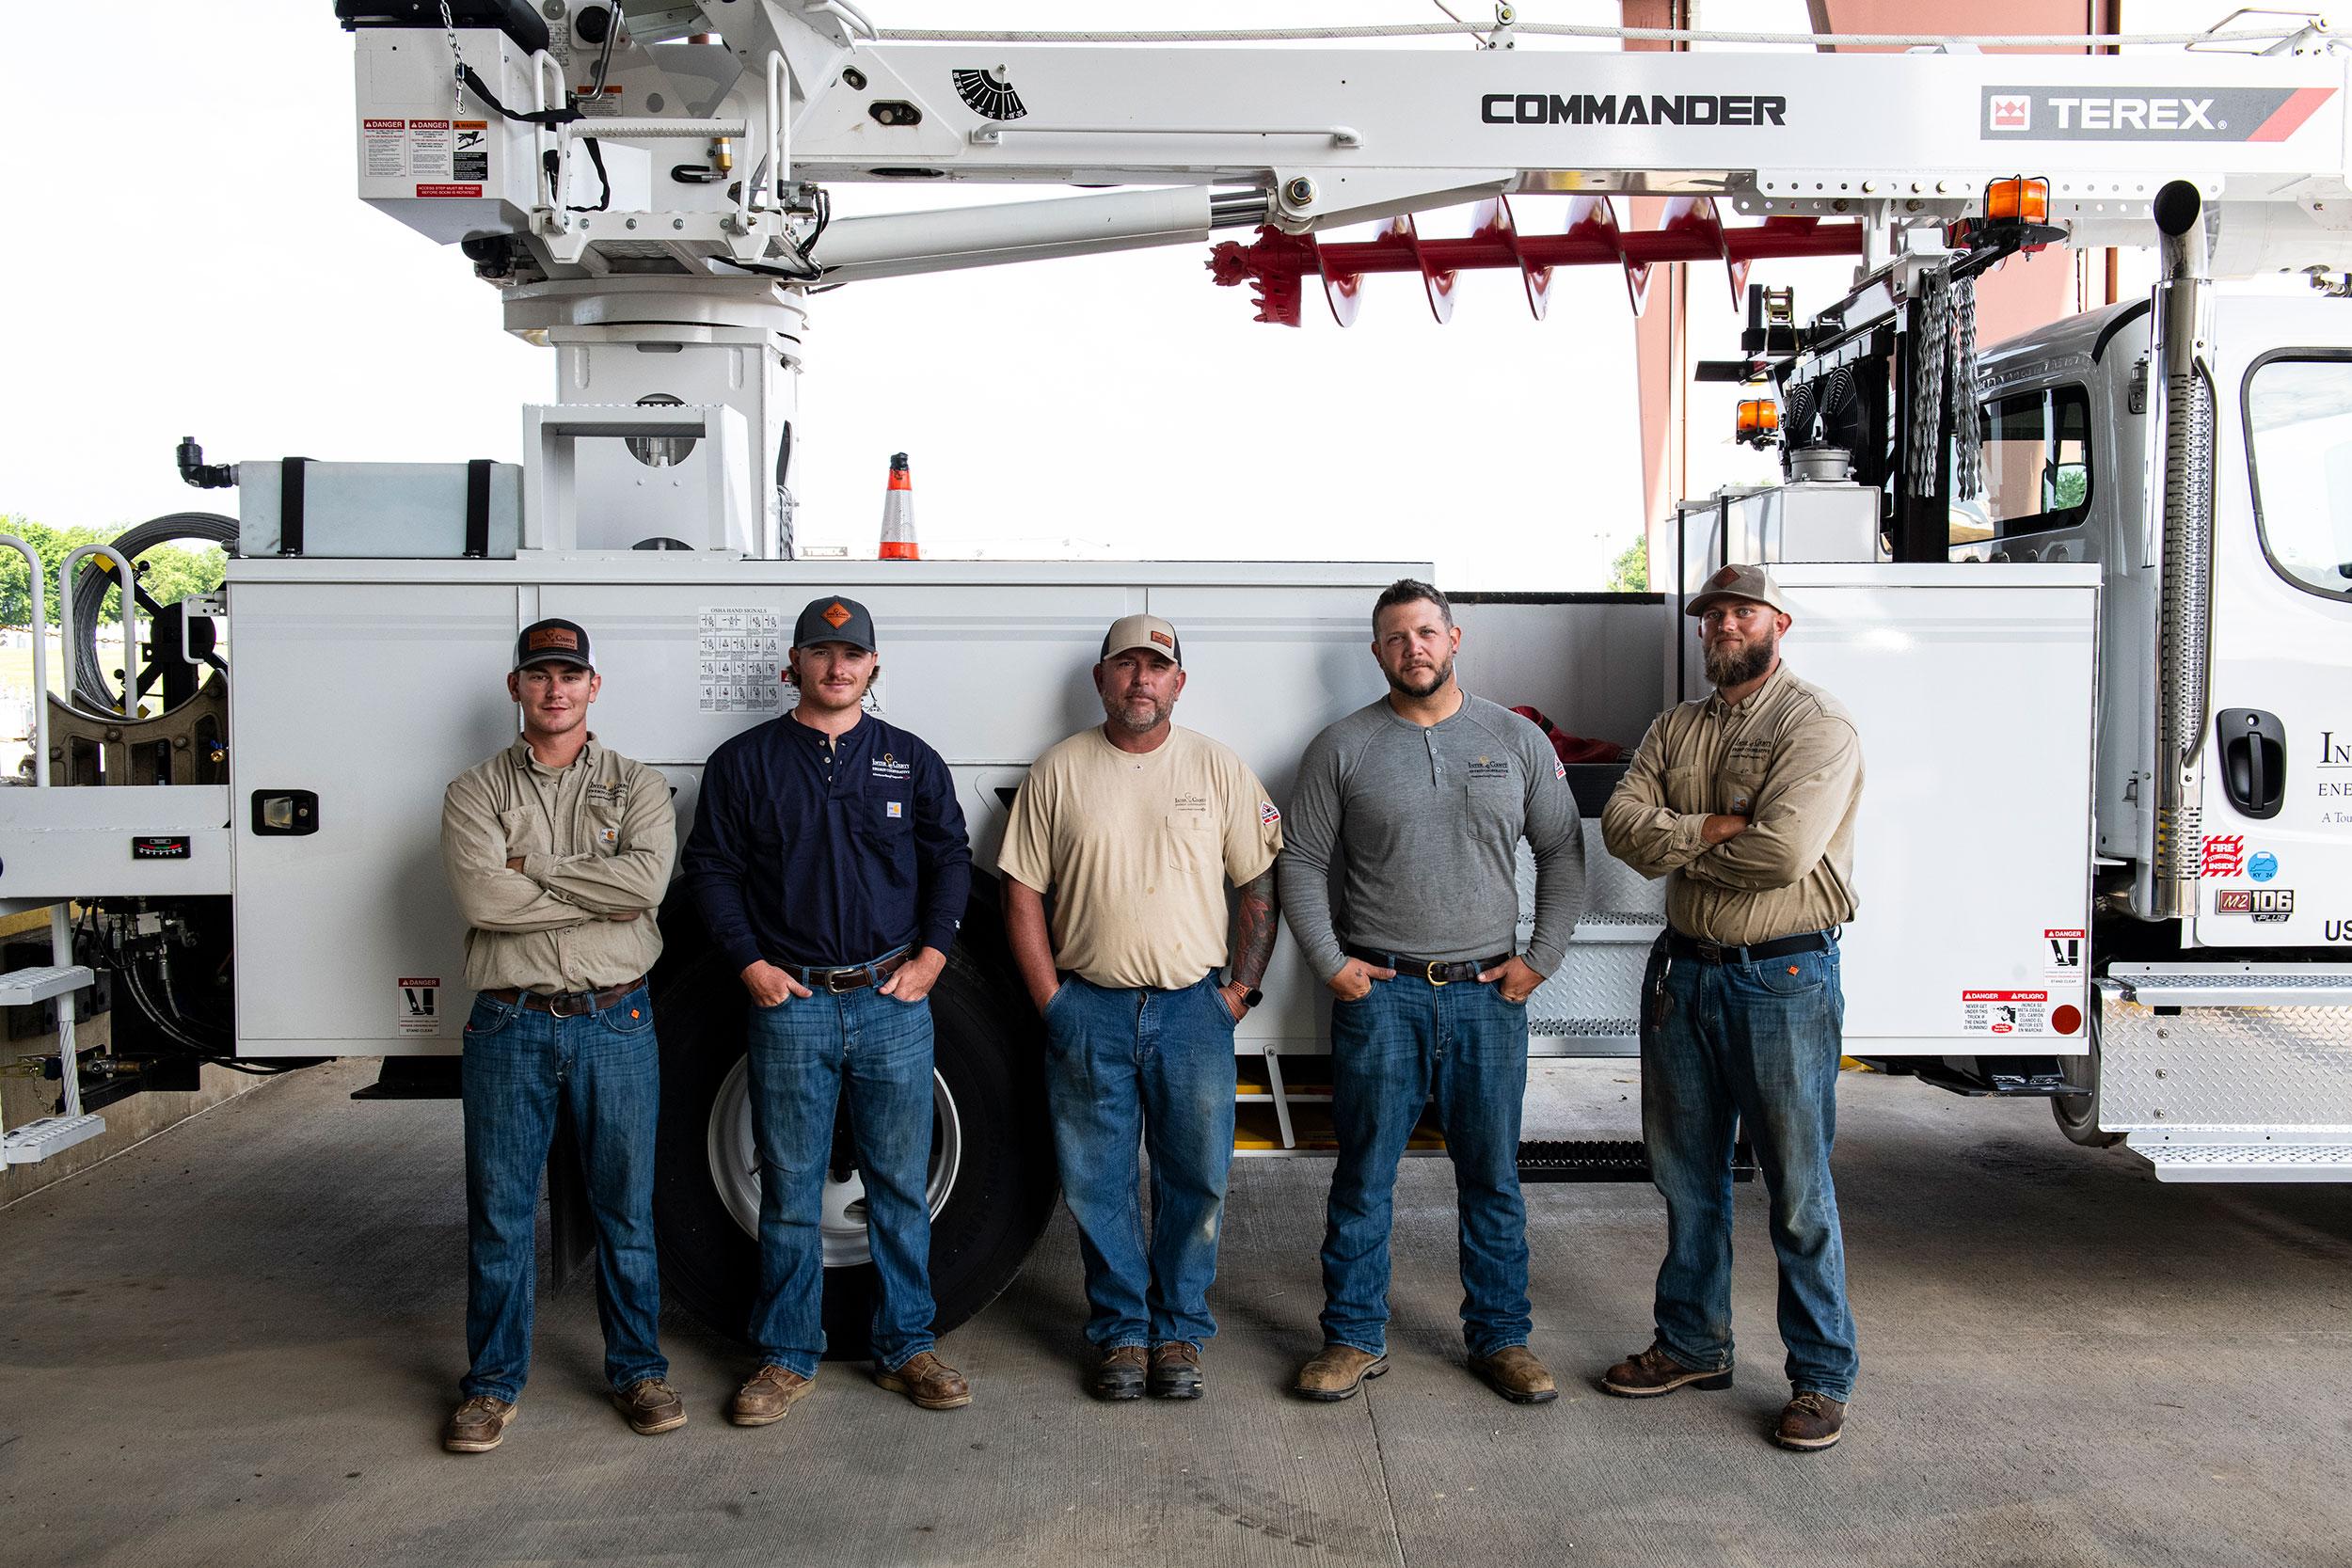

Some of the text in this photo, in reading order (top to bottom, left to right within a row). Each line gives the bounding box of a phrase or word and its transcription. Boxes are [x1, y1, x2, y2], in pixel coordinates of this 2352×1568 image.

[1481, 94, 1786, 126] COMMANDER
[2210, 844, 2235, 853] FIRE
[2223, 891, 2293, 912] M2 106
[2257, 914, 2287, 923] PLUS
